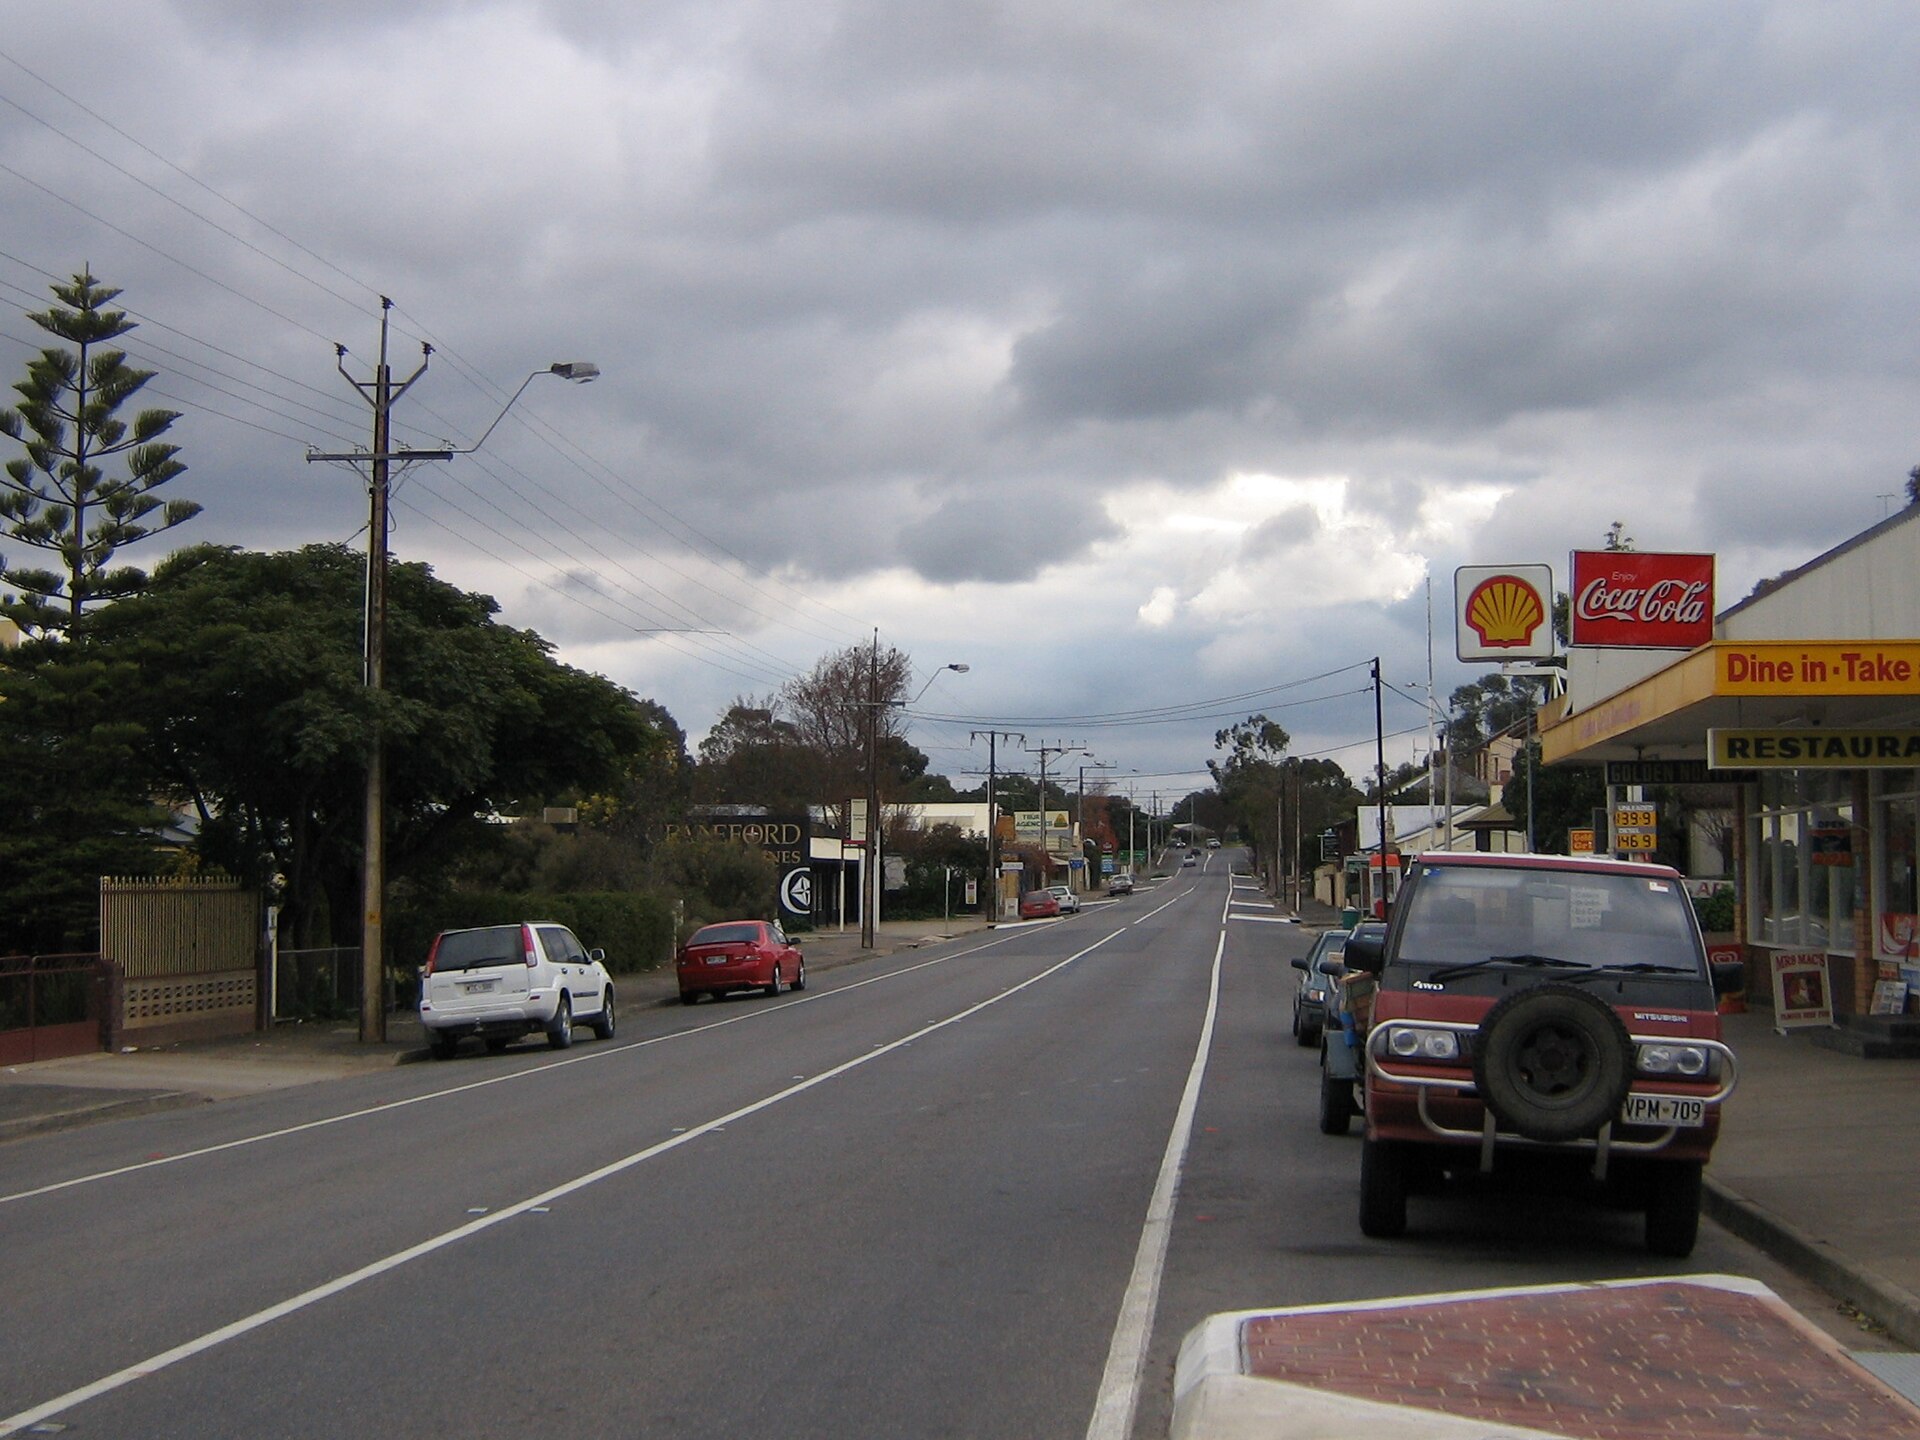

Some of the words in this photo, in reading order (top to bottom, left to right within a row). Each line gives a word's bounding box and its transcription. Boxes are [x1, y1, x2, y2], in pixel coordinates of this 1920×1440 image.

[1611, 571, 1638, 583] Enjoy
[1576, 577, 1710, 624] Coca-Cola
[1727, 653, 1794, 683] Dine
[1801, 654, 1827, 683] in
[1841, 653, 1911, 682] Take
[1611, 764, 1674, 782] GOLDEN
[1817, 820, 1845, 828] OPEN
[1413, 980, 1444, 990] 4WD
[1634, 1012, 1688, 1023] MITSUBISHI
